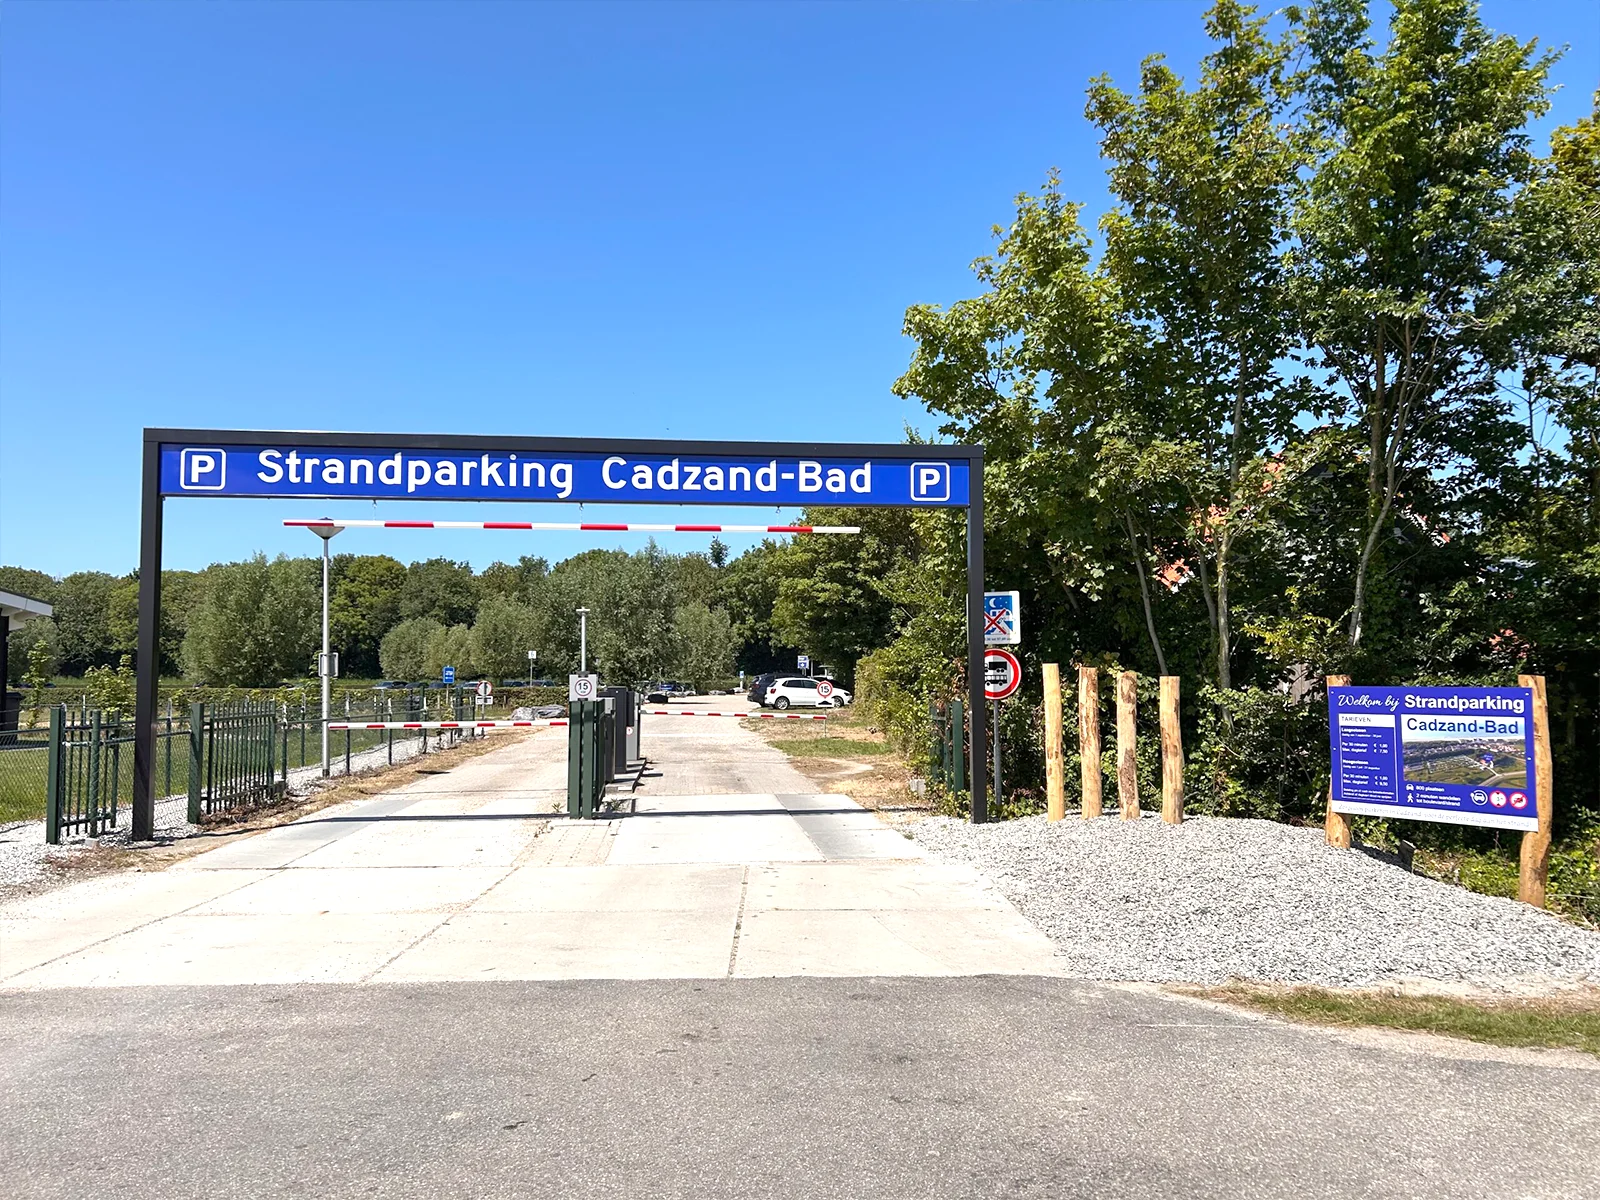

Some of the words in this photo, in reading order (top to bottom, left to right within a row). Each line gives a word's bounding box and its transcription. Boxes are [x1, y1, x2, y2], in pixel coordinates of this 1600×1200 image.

[191, 455, 216, 483] P
[256, 449, 574, 499] Strandparking
[601, 456, 872, 495] Cadzand-Bad
[919, 468, 941, 496] P
[577, 682, 589, 691] 15
[820, 685, 830, 694] 15
[1338, 694, 1383, 708] Welkom
[1384, 695, 1400, 711] bij
[1404, 694, 1525, 714] Strandparking
[1407, 718, 1519, 735] Cadzand-Bad
